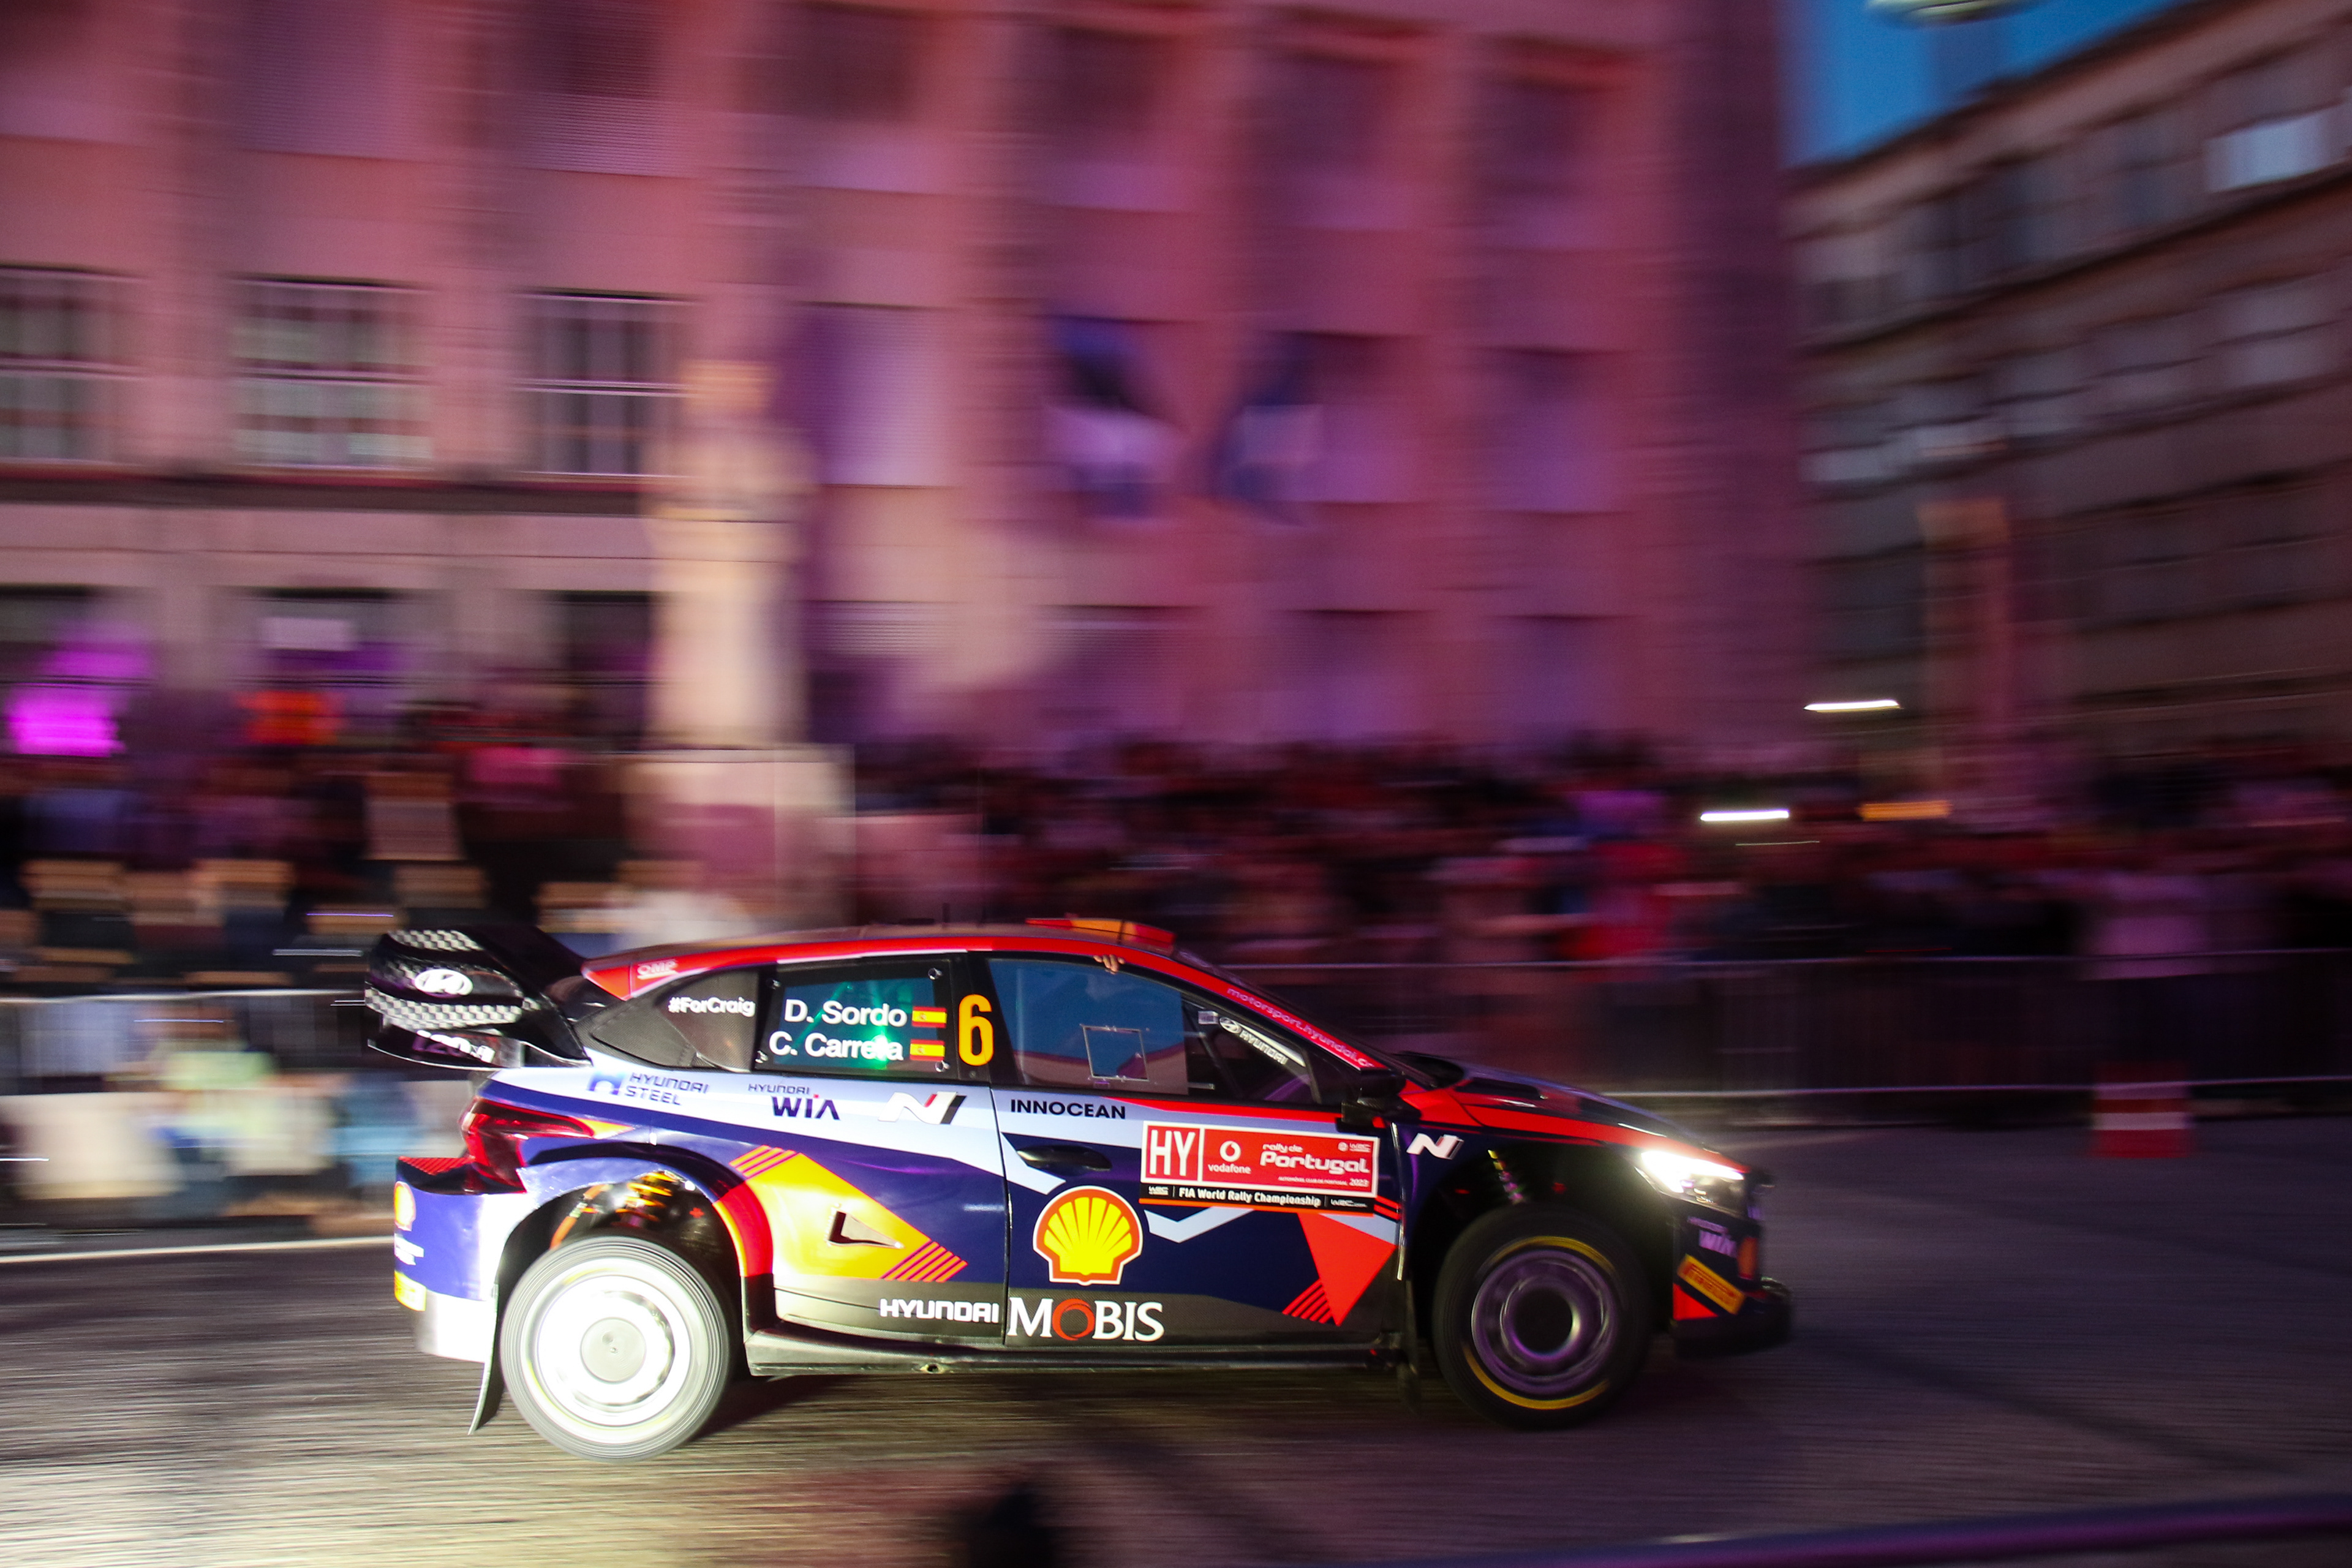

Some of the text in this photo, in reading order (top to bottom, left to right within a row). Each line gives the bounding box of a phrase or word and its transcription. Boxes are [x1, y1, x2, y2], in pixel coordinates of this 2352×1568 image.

[668, 997, 756, 1017] #ForCraig
[784, 998, 907, 1027] D. Sordo
[958, 993, 993, 1066] 6
[769, 1031, 904, 1061] C. Carrea
[1239, 1030, 1289, 1065] HYUNDAI
[630, 1072, 710, 1094] HYUNDAI
[748, 1084, 810, 1095] HYUNDAI
[625, 1085, 681, 1106] STEEL
[1011, 1099, 1126, 1120] INNOCEAN
[1150, 1129, 1196, 1177] HY
[1262, 1143, 1303, 1153] rally de
[1208, 1164, 1251, 1175] vodafone
[1260, 1150, 1370, 1175] Portugal
[1179, 1187, 1322, 1208] FIA World Rally Championship
[880, 1297, 1165, 1342] HYUNDAI MOBIS
